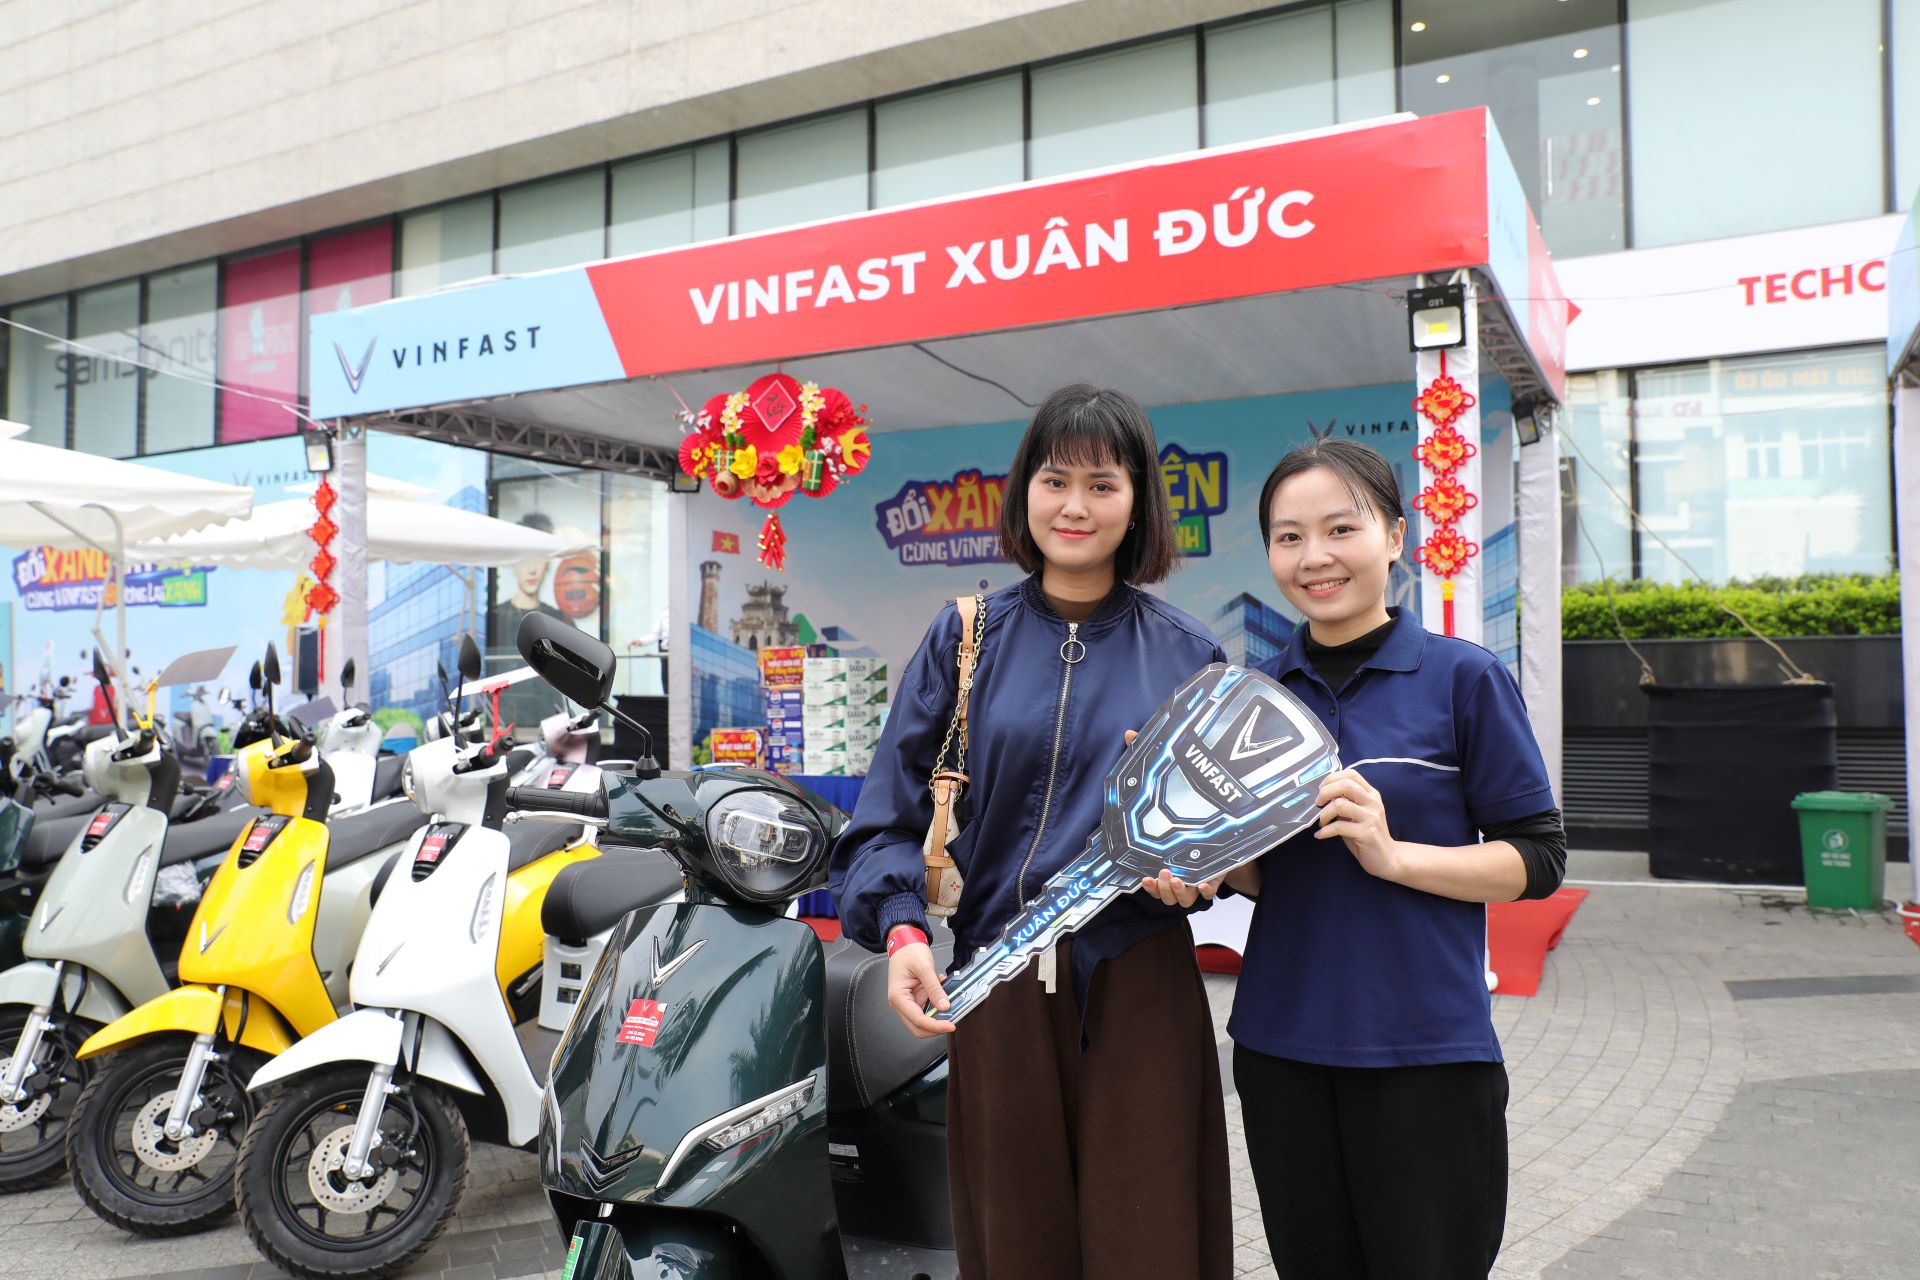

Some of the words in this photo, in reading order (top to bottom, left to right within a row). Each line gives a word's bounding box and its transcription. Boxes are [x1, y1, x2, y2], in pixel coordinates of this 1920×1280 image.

[689, 251, 927, 325] VINFAST
[944, 215, 1130, 289] XUÂN
[1152, 185, 1316, 257] ĐỨC
[392, 325, 541, 369] VINFAST
[1345, 420, 1418, 436] VINFA
[1184, 743, 1243, 804] VINFAST
[1012, 905, 1057, 947] XUÂN
[1056, 877, 1091, 909] ĐỨC
